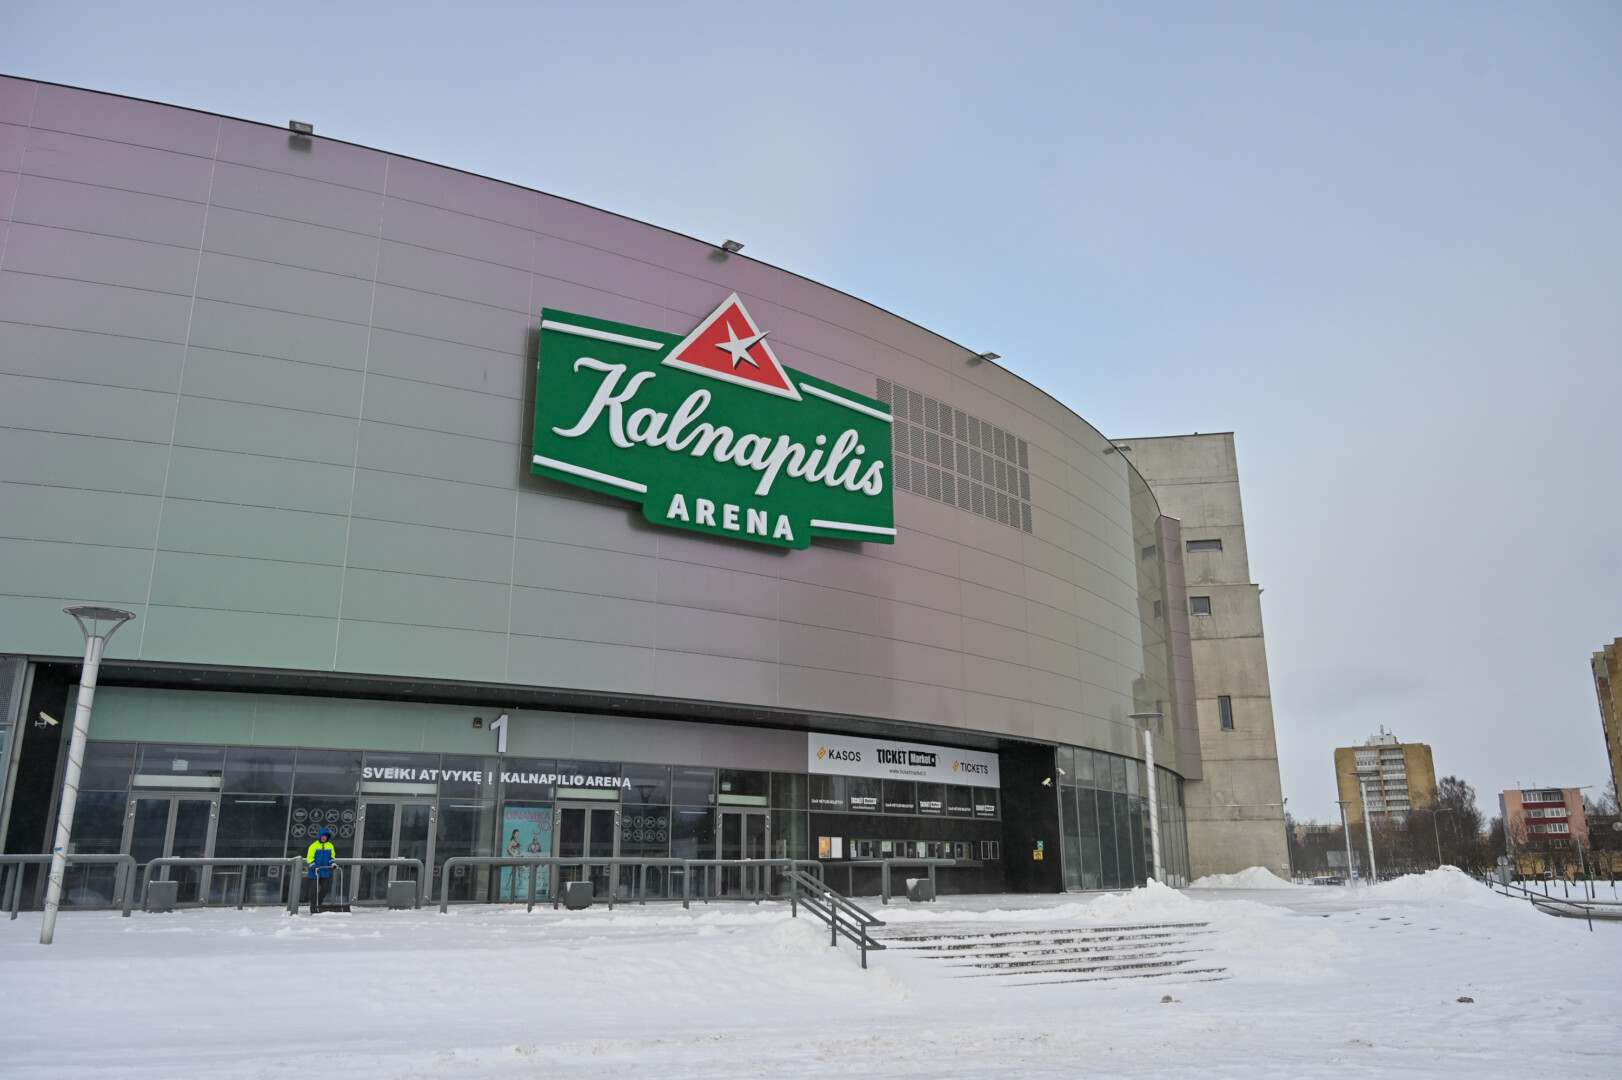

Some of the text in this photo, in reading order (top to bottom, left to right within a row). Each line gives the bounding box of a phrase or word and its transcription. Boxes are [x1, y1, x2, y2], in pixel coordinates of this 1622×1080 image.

[552, 357, 884, 496] Kalnapilis
[667, 494, 794, 541] ARENA
[490, 714, 508, 752] 1
[828, 749, 861, 762] KASOS
[877, 749, 907, 764] TICKET
[960, 762, 988, 774] TICKETS
[363, 767, 415, 779] SVEIKI
[500, 772, 584, 786] KALNAPILIO
[585, 775, 632, 790] ARENĄ
[505, 811, 551, 820] DINAMIKA
